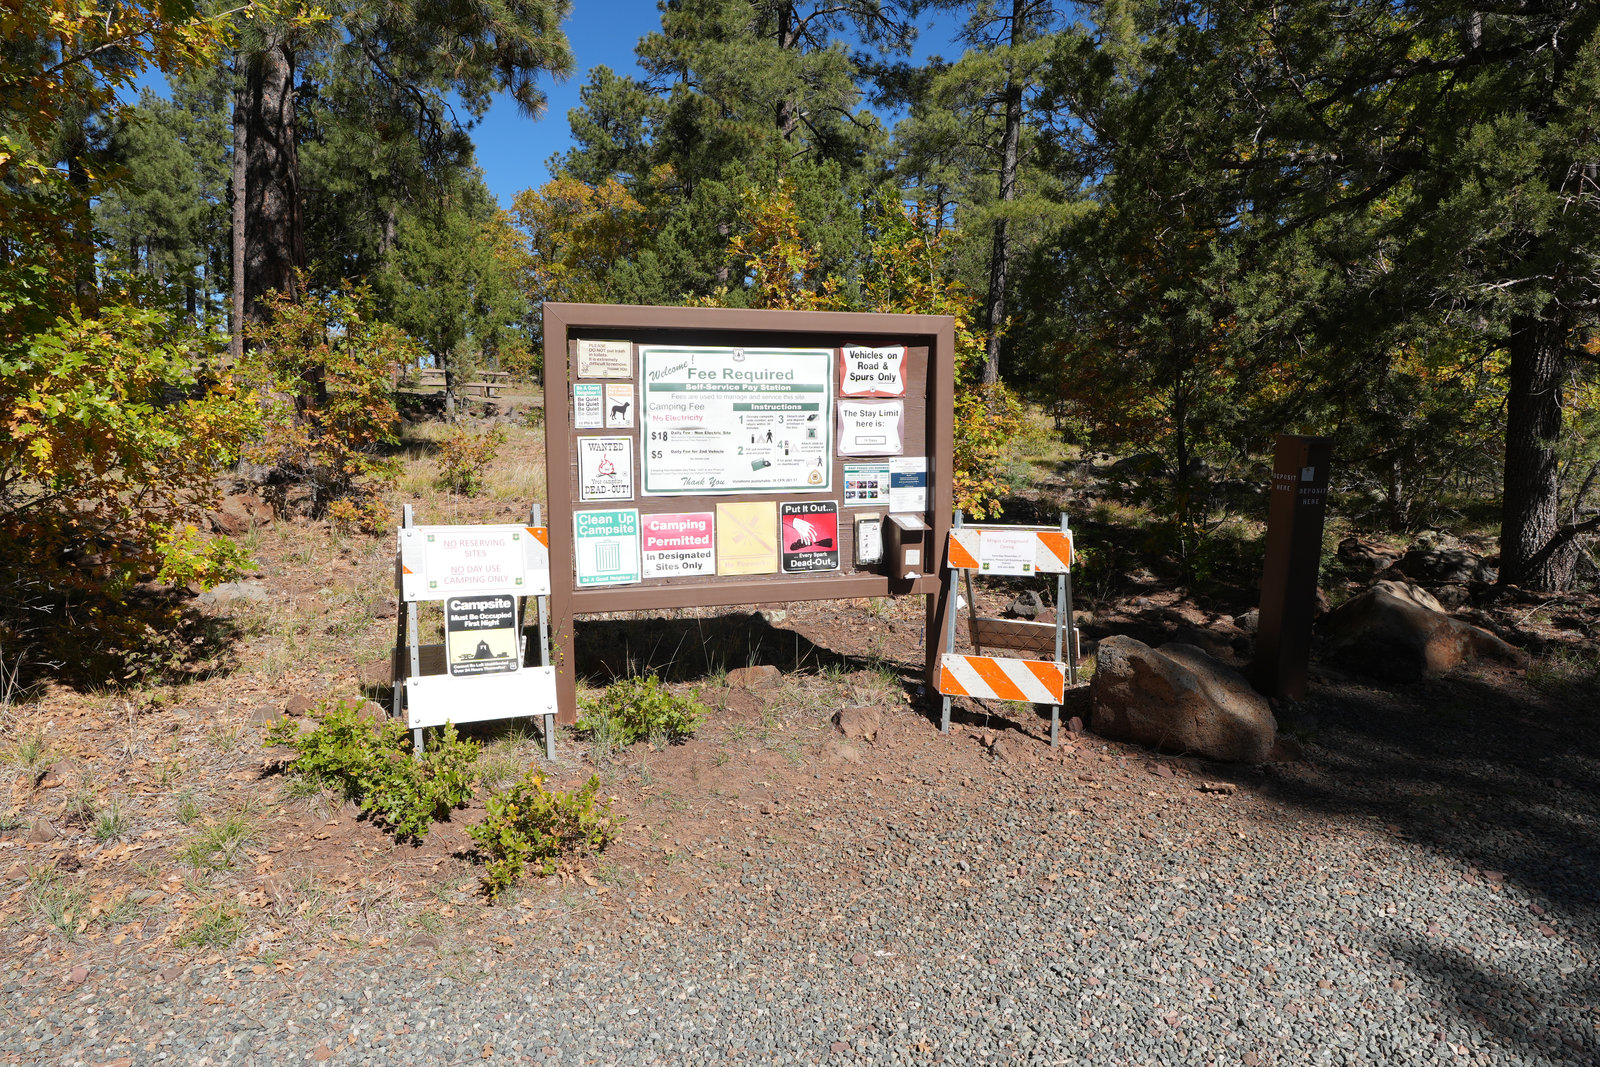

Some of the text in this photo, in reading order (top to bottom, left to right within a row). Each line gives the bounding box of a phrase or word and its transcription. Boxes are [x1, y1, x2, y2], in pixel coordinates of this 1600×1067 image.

[849, 350, 898, 360] Vehicles on
[857, 361, 889, 370] Road &
[688, 367, 794, 382] Fee Required
[850, 372, 896, 382] Spurs Only
[685, 383, 740, 391] Self-Service
[742, 384, 758, 392] Pay
[649, 402, 705, 412] Camping Fee
[652, 414, 703, 422] No Electricity
[860, 409, 876, 418] Stay
[738, 415, 744, 424] 1
[778, 414, 784, 424] 3
[651, 431, 668, 442] $18
[588, 442, 624, 451] WANTED
[777, 440, 783, 449] 4
[651, 450, 663, 459] $5
[738, 446, 744, 455] 2
[681, 476, 725, 487] Thank You
[802, 505, 808, 513] It
[810, 504, 834, 512] Out...
[579, 513, 634, 525] Clean Up
[579, 524, 635, 536] Campsite
[650, 519, 706, 532] Camping
[460, 538, 506, 547] RESERVING
[647, 535, 710, 547] Permitted
[658, 550, 711, 561] Designated
[656, 561, 703, 571] Sites Only
[790, 558, 831, 568] Dead-Out
[467, 565, 483, 573] DAY
[485, 564, 501, 572] USE
[444, 576, 485, 584] CAMPING
[450, 598, 511, 611] Campsite
